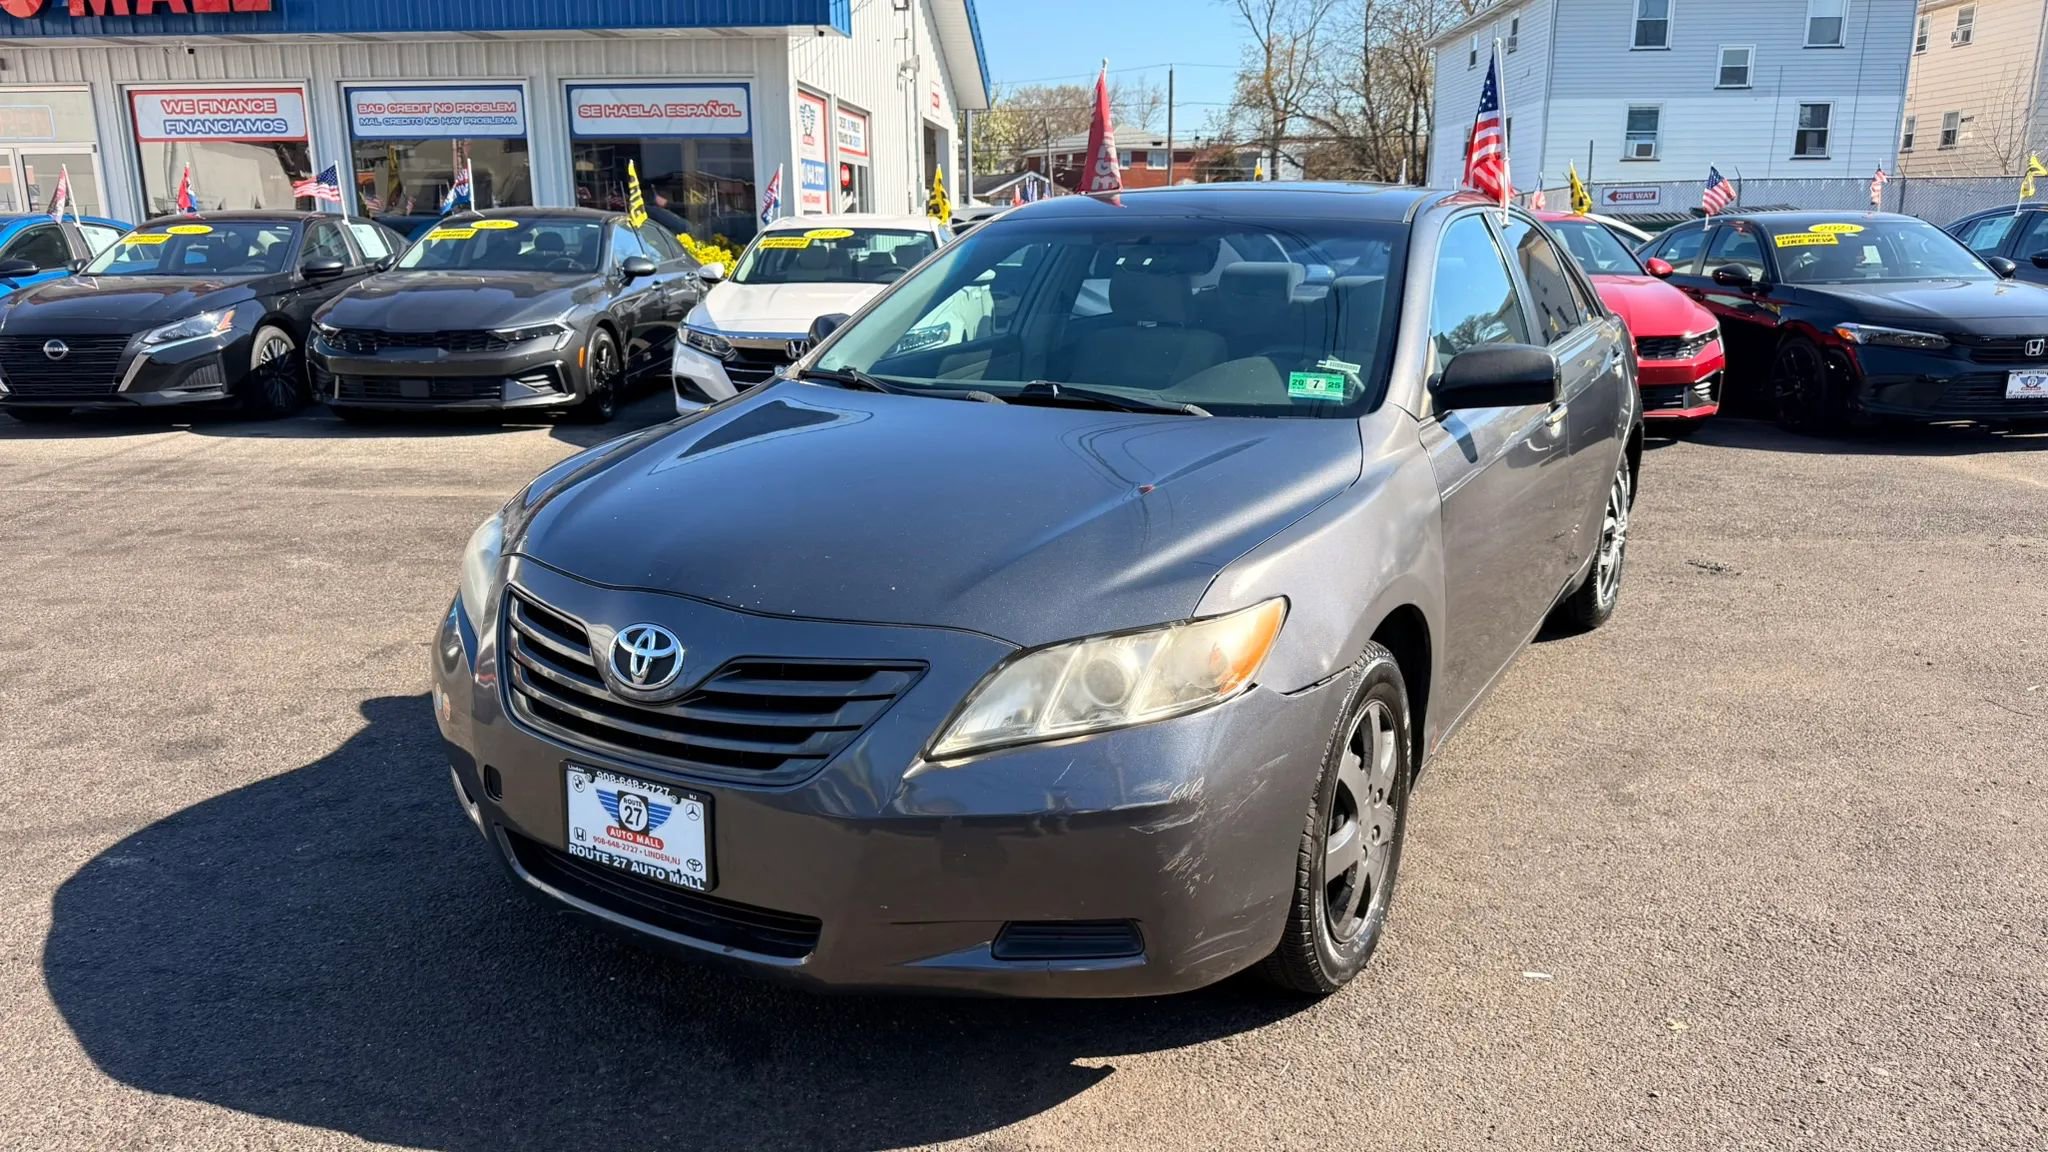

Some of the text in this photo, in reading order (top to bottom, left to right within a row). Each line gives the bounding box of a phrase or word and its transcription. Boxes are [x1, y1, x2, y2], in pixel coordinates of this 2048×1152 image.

[161, 98, 277, 114] WE FINANCE
[357, 101, 517, 114] BAD CREDIT NO PROBLEM
[578, 99, 742, 118] SE HABLA ESPAÑOL
[164, 117, 288, 135] FINANCIAMOS
[359, 116, 517, 126] MAL CREDITO NO HAY PROBLEMA
[1616, 191, 1654, 200] ONE WAY
[1313, 380, 1320, 388] 7
[623, 798, 643, 808] ROUTE
[624, 806, 643, 826] 27
[593, 836, 638, 855] 908-648-2727
[609, 828, 661, 848] AUTO MALL
[568, 844, 705, 891] ROUTE 27 AUTO MALL
